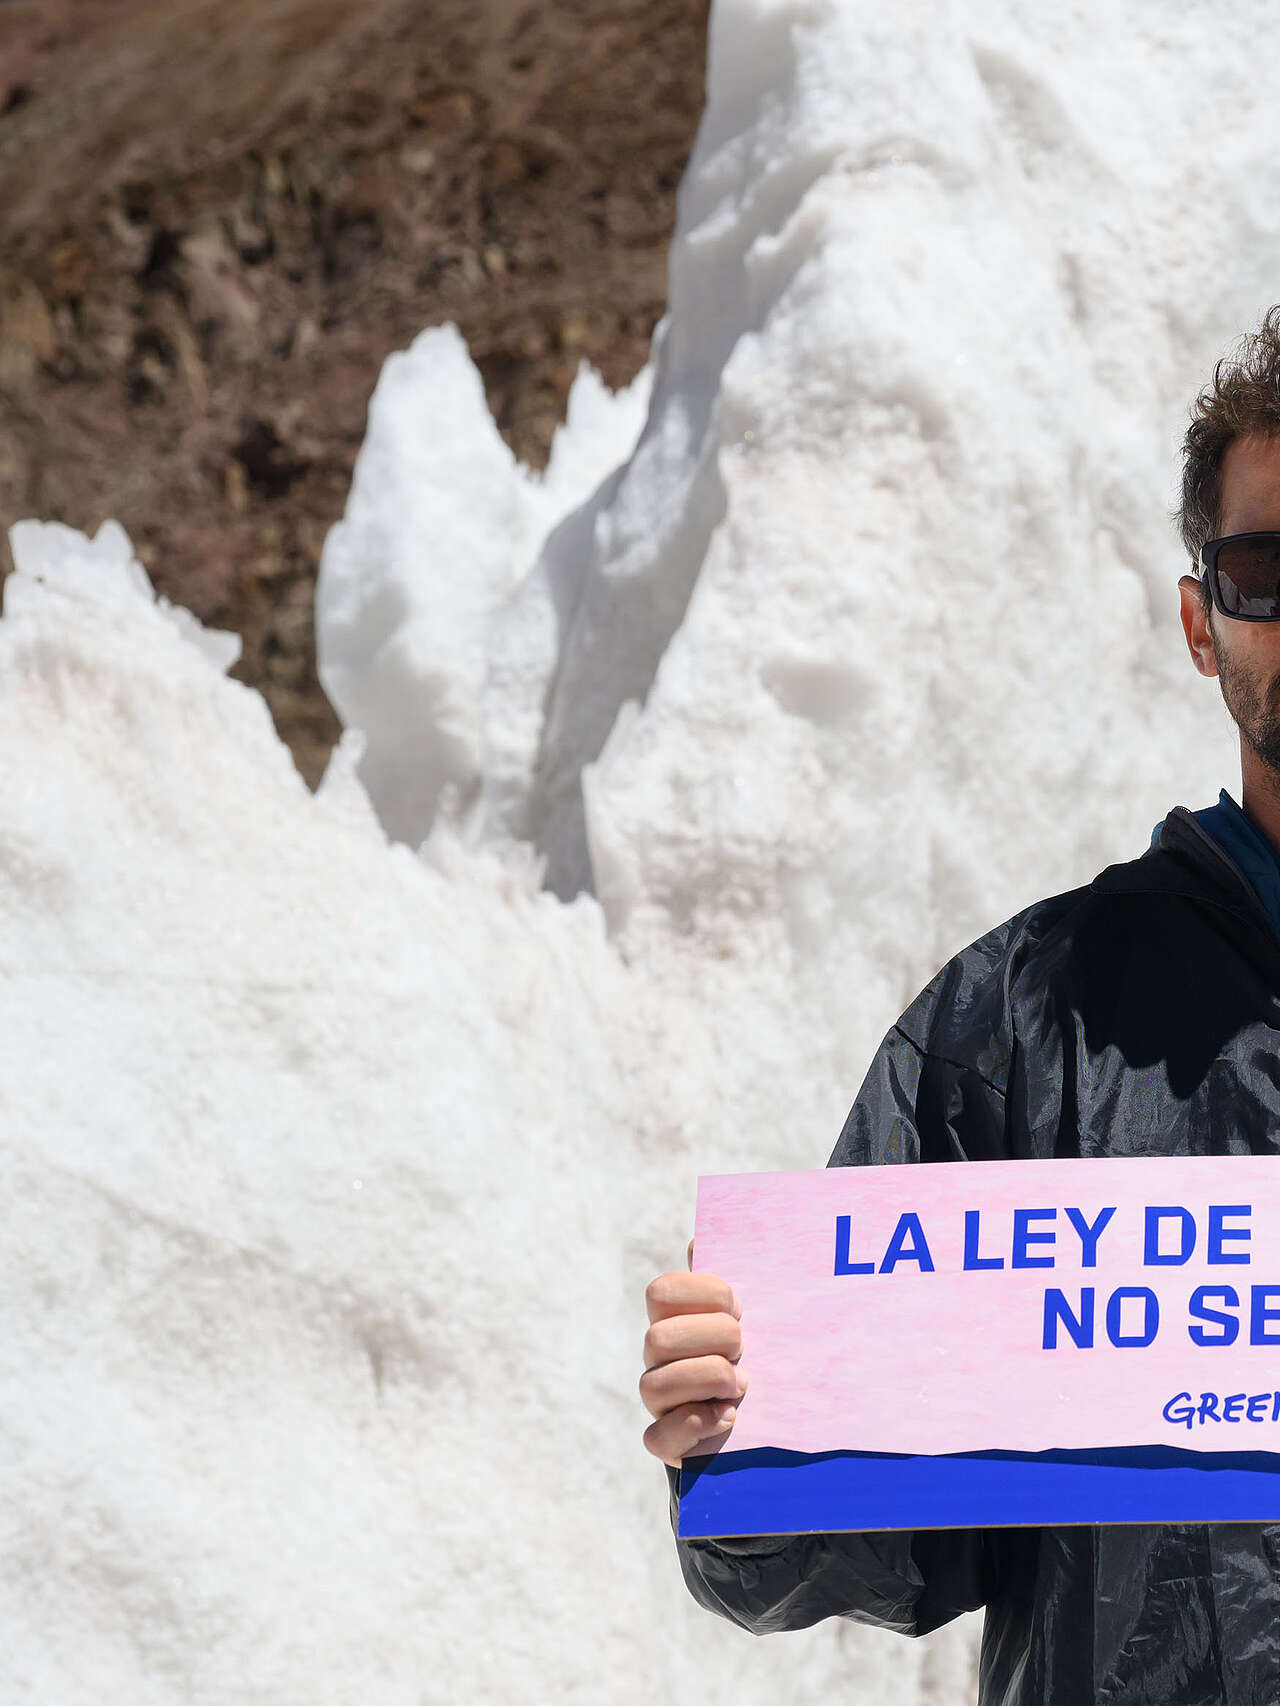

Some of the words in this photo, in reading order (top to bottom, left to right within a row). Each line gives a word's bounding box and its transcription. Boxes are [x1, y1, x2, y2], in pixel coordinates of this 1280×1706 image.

[834, 1213, 934, 1276] LA
[964, 1208, 1116, 1270] LEY
[1144, 1205, 1251, 1265] DE
[1043, 1287, 1159, 1349] NO
